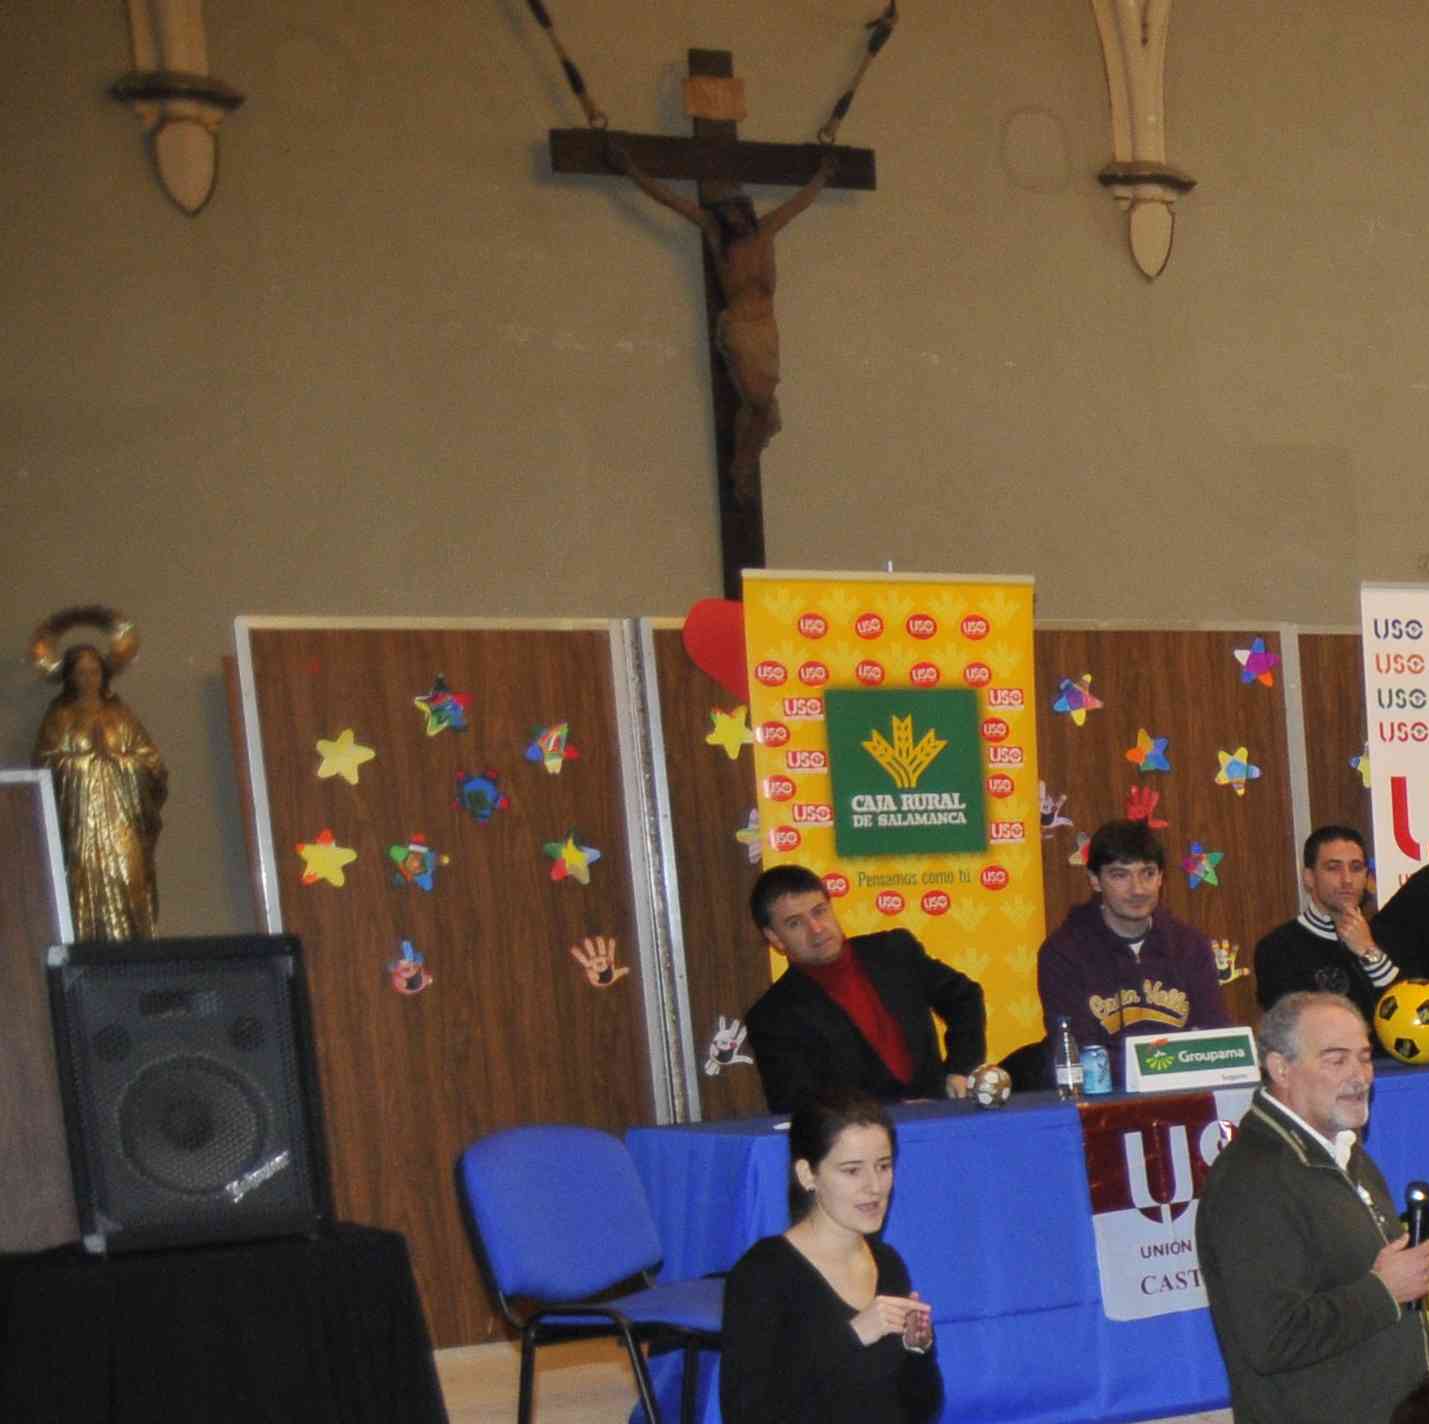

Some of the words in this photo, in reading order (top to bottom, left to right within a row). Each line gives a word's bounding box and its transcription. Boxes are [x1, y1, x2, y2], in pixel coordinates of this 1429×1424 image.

[1374, 619, 1422, 640] USO
[1376, 654, 1424, 674] USO
[1378, 689, 1427, 708] USO
[1379, 722, 1428, 742] USO
[852, 794, 897, 812] CAJA
[900, 792, 966, 811] RURAL
[853, 815, 872, 828] DE
[878, 813, 966, 827] SALAMANCA
[922, 871, 953, 885] como
[1178, 1047, 1245, 1062] Groupama
[1141, 1269, 1201, 1295] CAST
